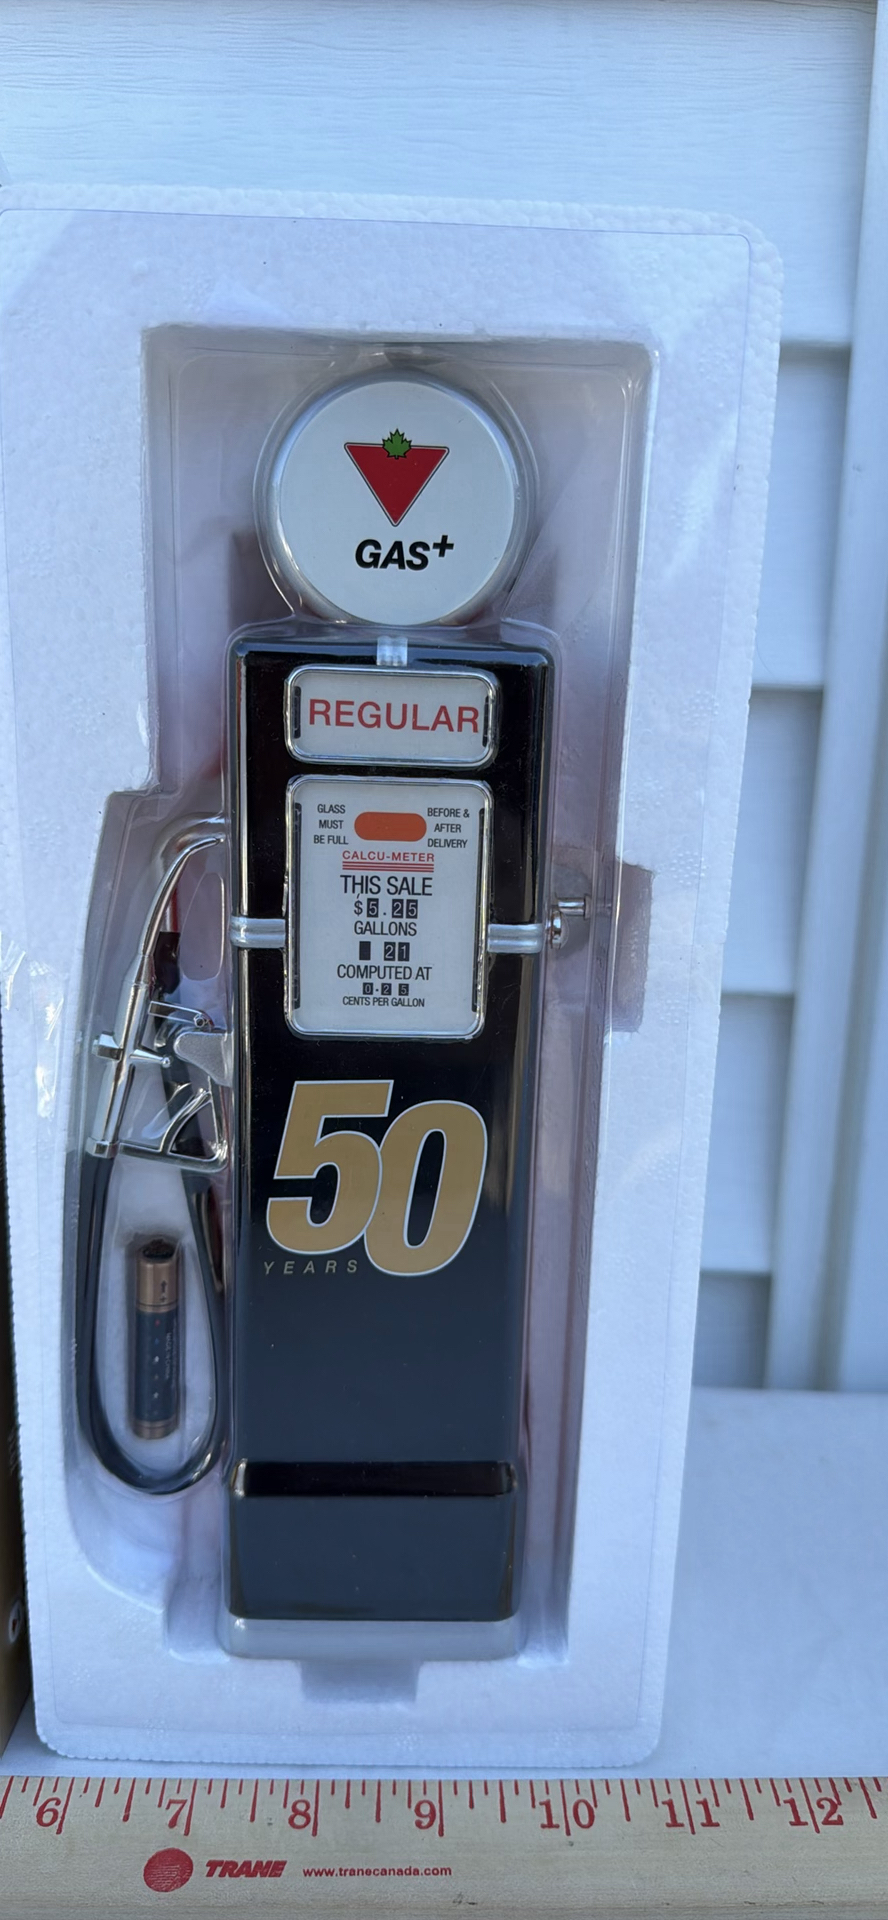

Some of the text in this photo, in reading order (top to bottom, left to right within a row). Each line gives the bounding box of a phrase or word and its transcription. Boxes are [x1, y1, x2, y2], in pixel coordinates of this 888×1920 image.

[355, 535, 454, 571] GAS+
[309, 699, 479, 733] REGULAR
[317, 804, 346, 814] GLASS
[427, 808, 470, 818] BEFORE &
[318, 820, 344, 829] MUST
[434, 823, 461, 833] AFTER
[313, 835, 348, 845] BE FULL
[427, 838, 468, 848] DELIVERY
[342, 850, 435, 862] CALCU-METER
[340, 875, 433, 896] THIS SALE
[354, 920, 417, 936] GALLONS
[384, 943, 408, 960] 21
[337, 964, 432, 980] COMPUTED AT
[342, 996, 425, 1007] CENTS PER GALLON
[266, 1080, 488, 1277] 50
[264, 1260, 358, 1275] YEARS
[35, 1797, 844, 1829] 6 7 8 9 10 11 12
[205, 1860, 452, 1878] TRANE www.tranecanada.com
